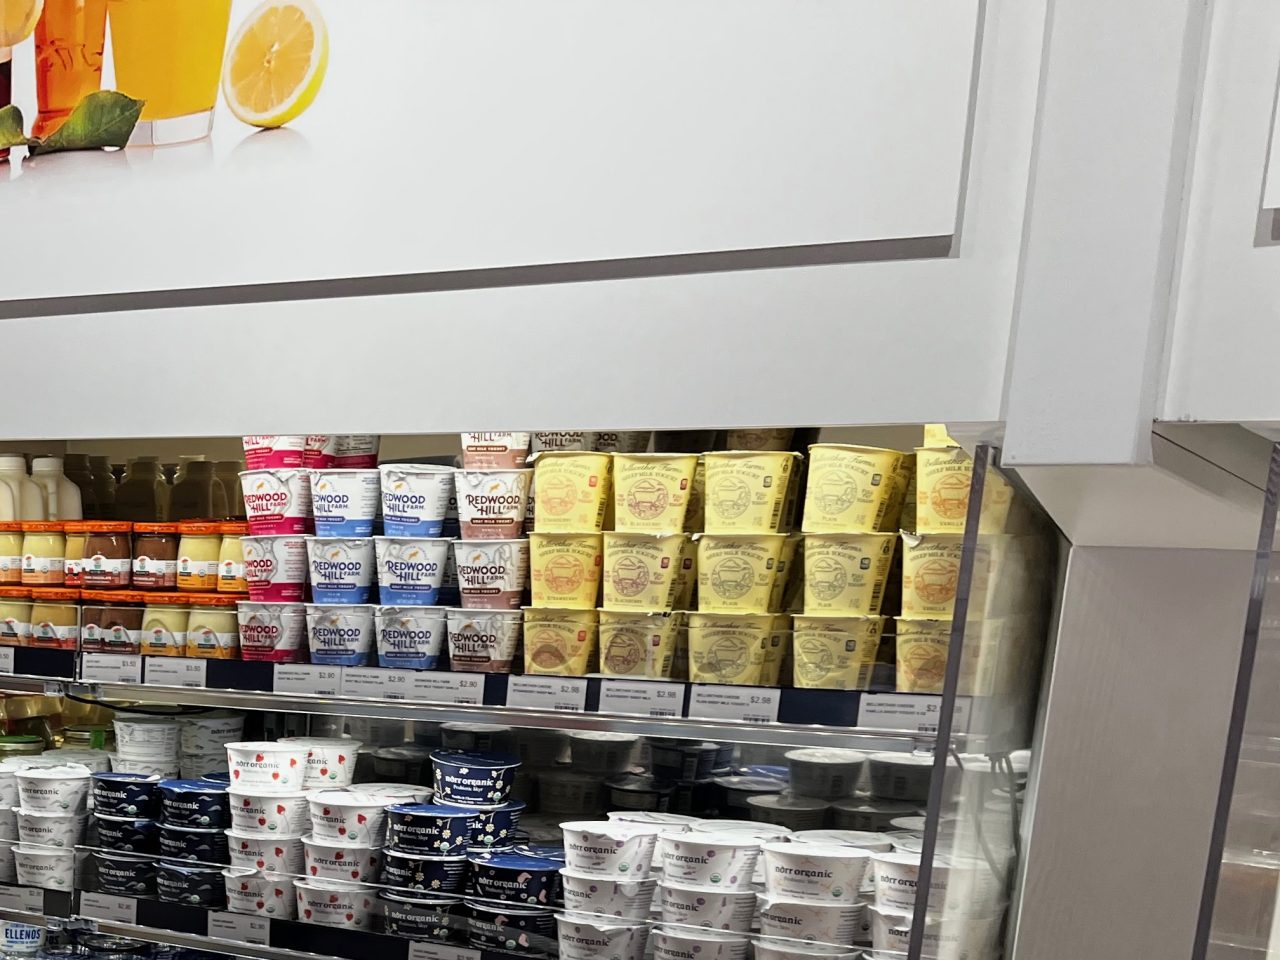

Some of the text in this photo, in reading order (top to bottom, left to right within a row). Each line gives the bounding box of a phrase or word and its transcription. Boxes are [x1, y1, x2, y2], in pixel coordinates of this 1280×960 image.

[466, 495, 520, 506] REDWOOD
[250, 503, 271, 513] HILL
[476, 505, 503, 516] HILL
[313, 560, 362, 573] REDWOOD
[385, 560, 437, 573] REDWOOD
[312, 627, 360, 638] REDWOOD
[381, 629, 431, 641] REDWOOD
[390, 639, 415, 649] HILL
[463, 778, 494, 787] organic
[101, 790, 127, 800] organic
[407, 826, 439, 835] organic
[675, 854, 709, 865] organic
[794, 868, 832, 879] organic
[5, 928, 40, 941] ELLENOS
[662, 949, 696, 959] organic
